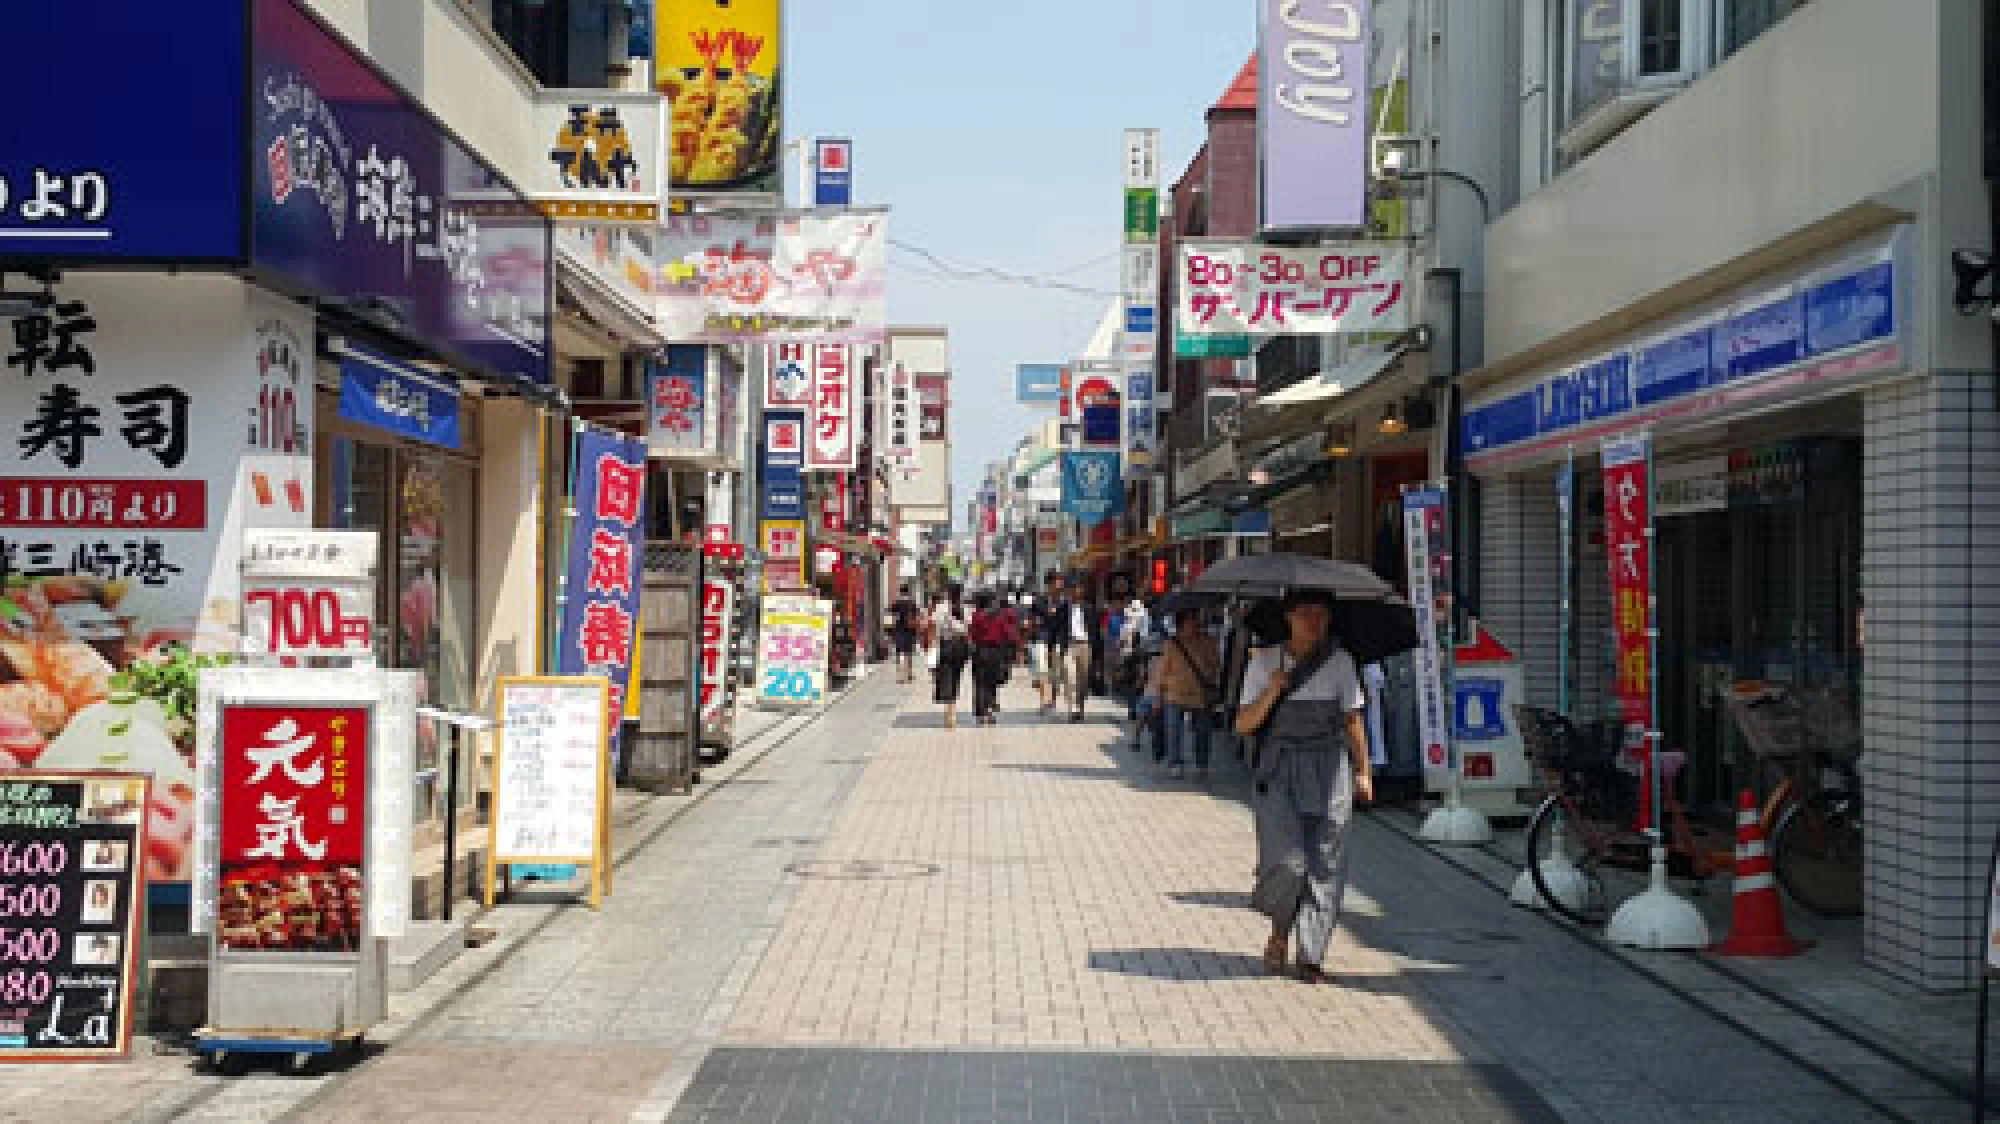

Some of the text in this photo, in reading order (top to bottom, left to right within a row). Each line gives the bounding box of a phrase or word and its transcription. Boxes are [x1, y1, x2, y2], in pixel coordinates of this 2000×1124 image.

[0, 167, 110, 220] より
[549, 148, 638, 189] てんや
[1318, 254, 1381, 283] OFF
[7, 301, 97, 377] 転
[816, 343, 847, 440] ラオケ
[18, 384, 193, 469] 寿司
[0, 486, 178, 522] 110円より
[246, 588, 371, 654] 700円
[243, 717, 329, 859] 元気
[0, 969, 51, 1003] 80
